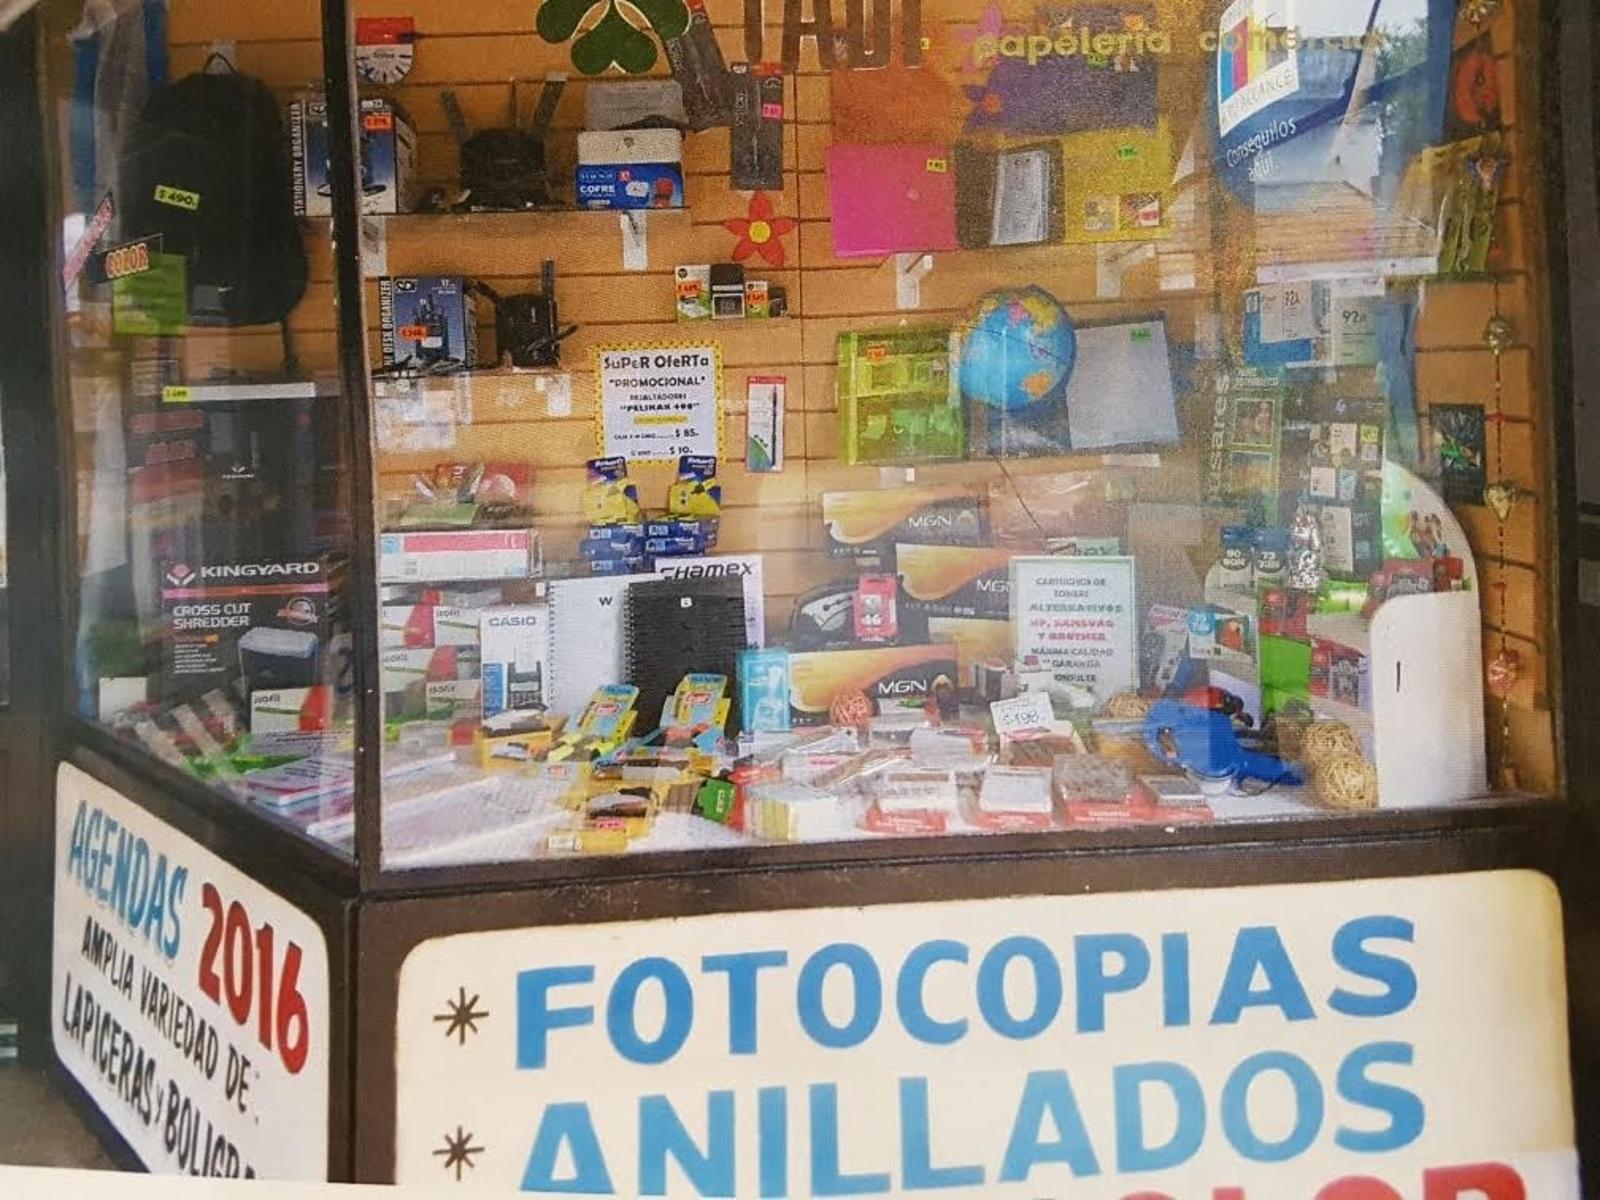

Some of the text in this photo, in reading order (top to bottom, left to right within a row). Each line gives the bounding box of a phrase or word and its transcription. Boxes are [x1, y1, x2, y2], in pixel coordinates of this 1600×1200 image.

[908, 516, 953, 529] MGN
[201, 561, 320, 578] KINGYARD
[172, 602, 252, 617] CROSS CUT
[172, 615, 250, 630] SHREDDER
[488, 616, 538, 628] CASIO
[878, 679, 928, 695] MGN
[66, 799, 311, 1076] AGENDAS 2016
[81, 915, 135, 1002] AMPLIA
[140, 966, 219, 1081] VARIEDAD
[515, 914, 1418, 1071] FOTOCOPIAS
[62, 971, 156, 1127] LAPICERAS
[519, 1040, 1427, 1198] ANILLADOS
